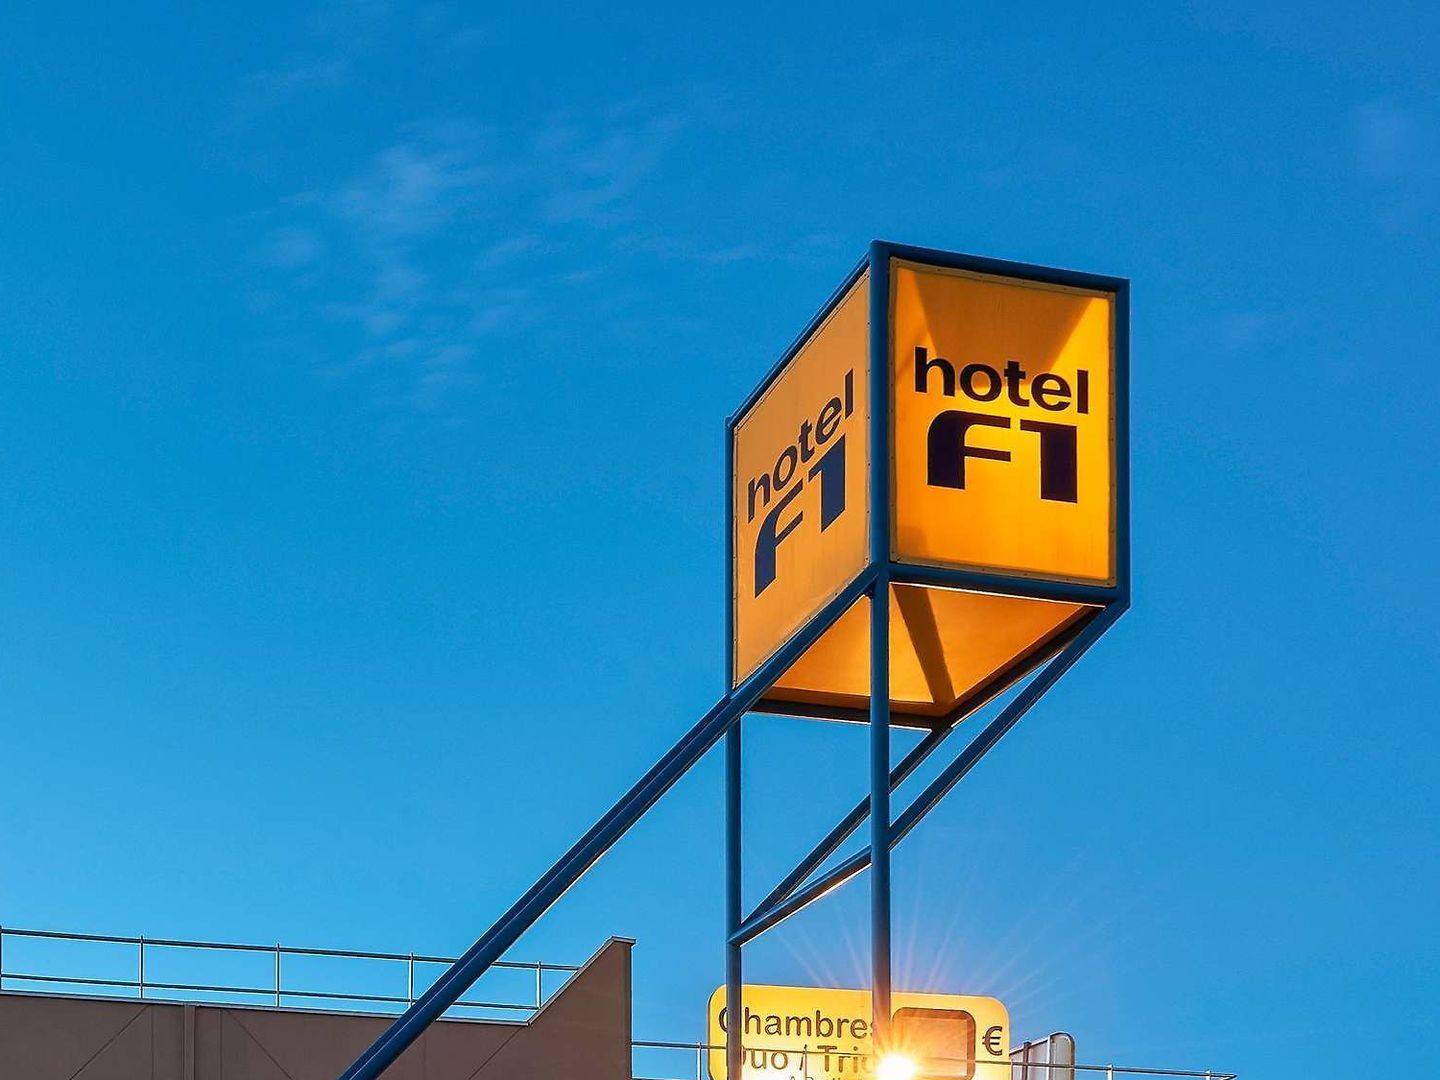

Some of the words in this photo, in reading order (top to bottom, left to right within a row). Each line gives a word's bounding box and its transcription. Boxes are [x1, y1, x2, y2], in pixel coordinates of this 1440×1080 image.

[914, 346, 1089, 414] hotel
[747, 368, 855, 522] hotel
[926, 409, 1079, 504] F1
[754, 432, 847, 600] F1
[741, 1045, 789, 1071] uo
[981, 1025, 1003, 1056] €
